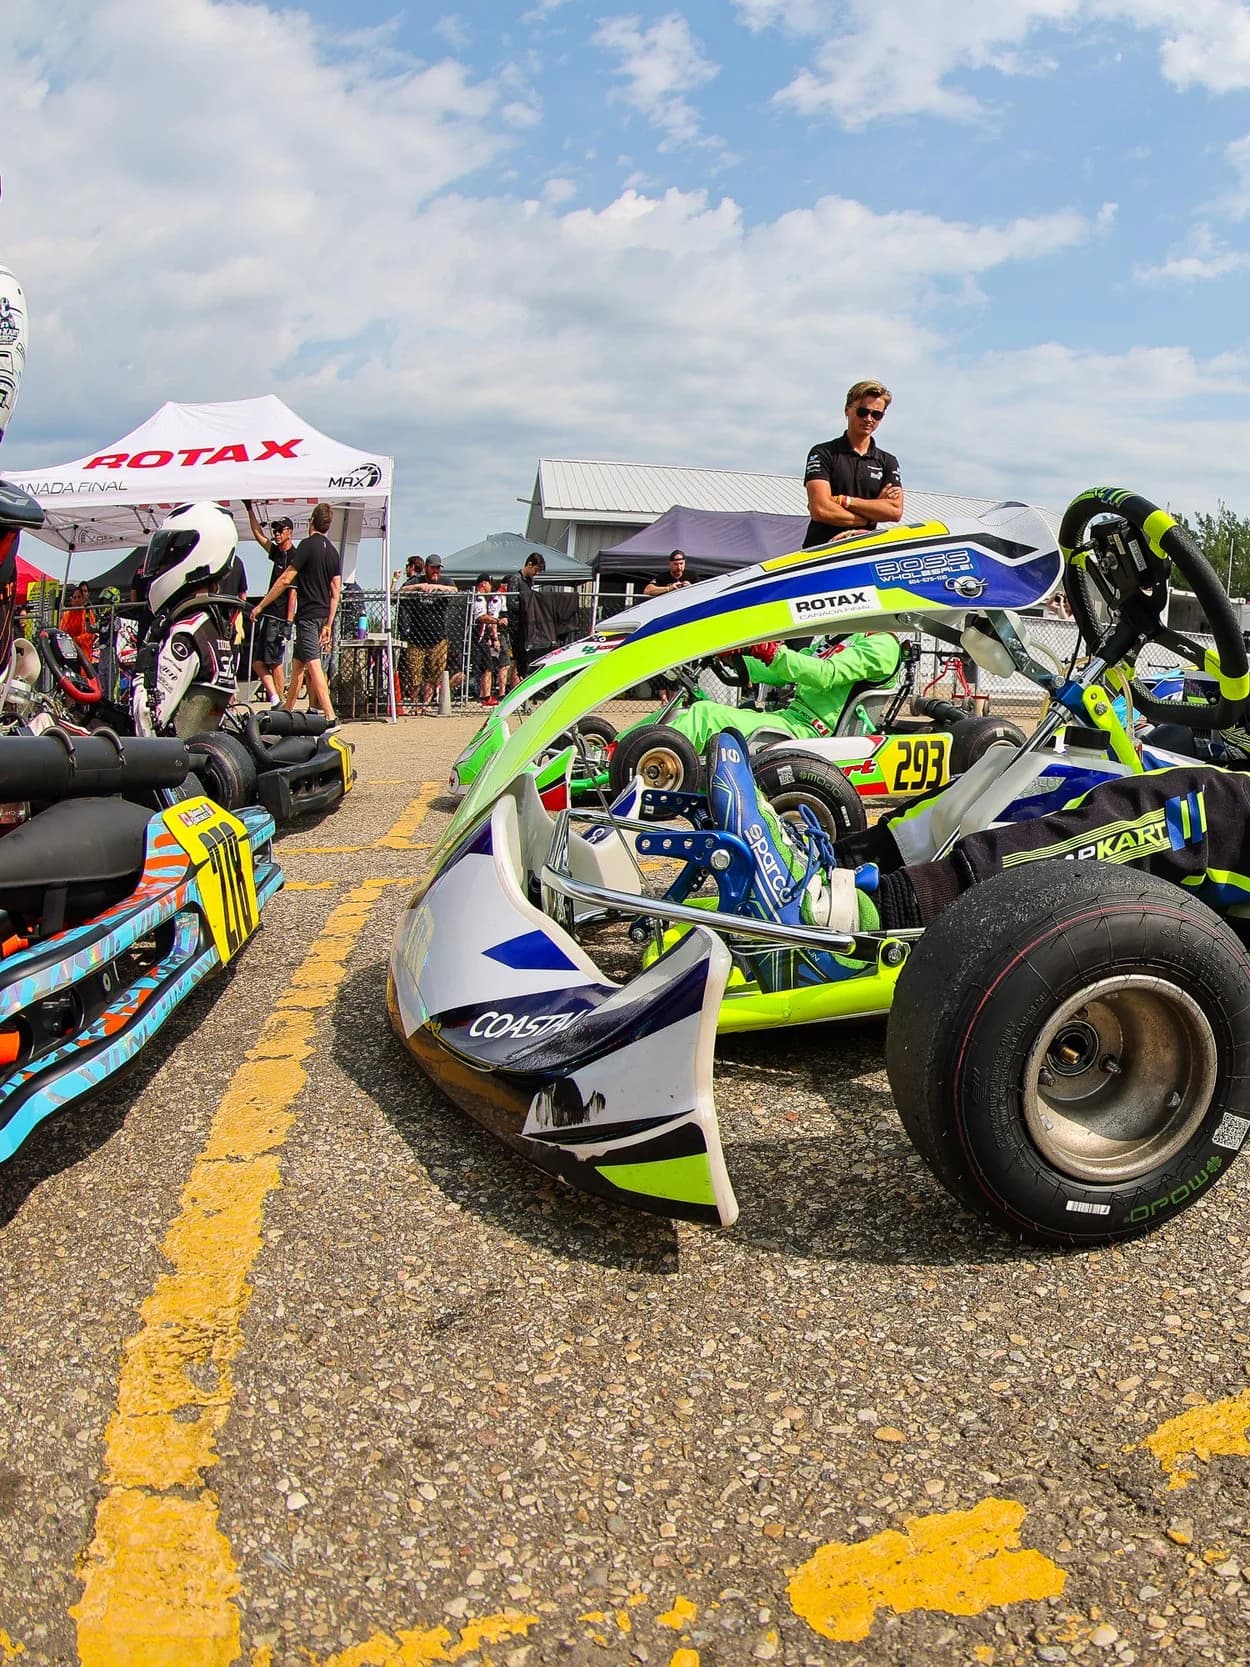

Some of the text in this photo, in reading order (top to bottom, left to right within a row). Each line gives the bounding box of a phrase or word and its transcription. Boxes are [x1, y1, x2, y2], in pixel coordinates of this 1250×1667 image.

[82, 438, 305, 470] ROTAX
[19, 479, 129, 495] ANADA FINAL
[328, 475, 366, 489] MAX
[875, 549, 971, 576] BOSS
[795, 591, 867, 613] ROTAX
[893, 740, 945, 791] 293
